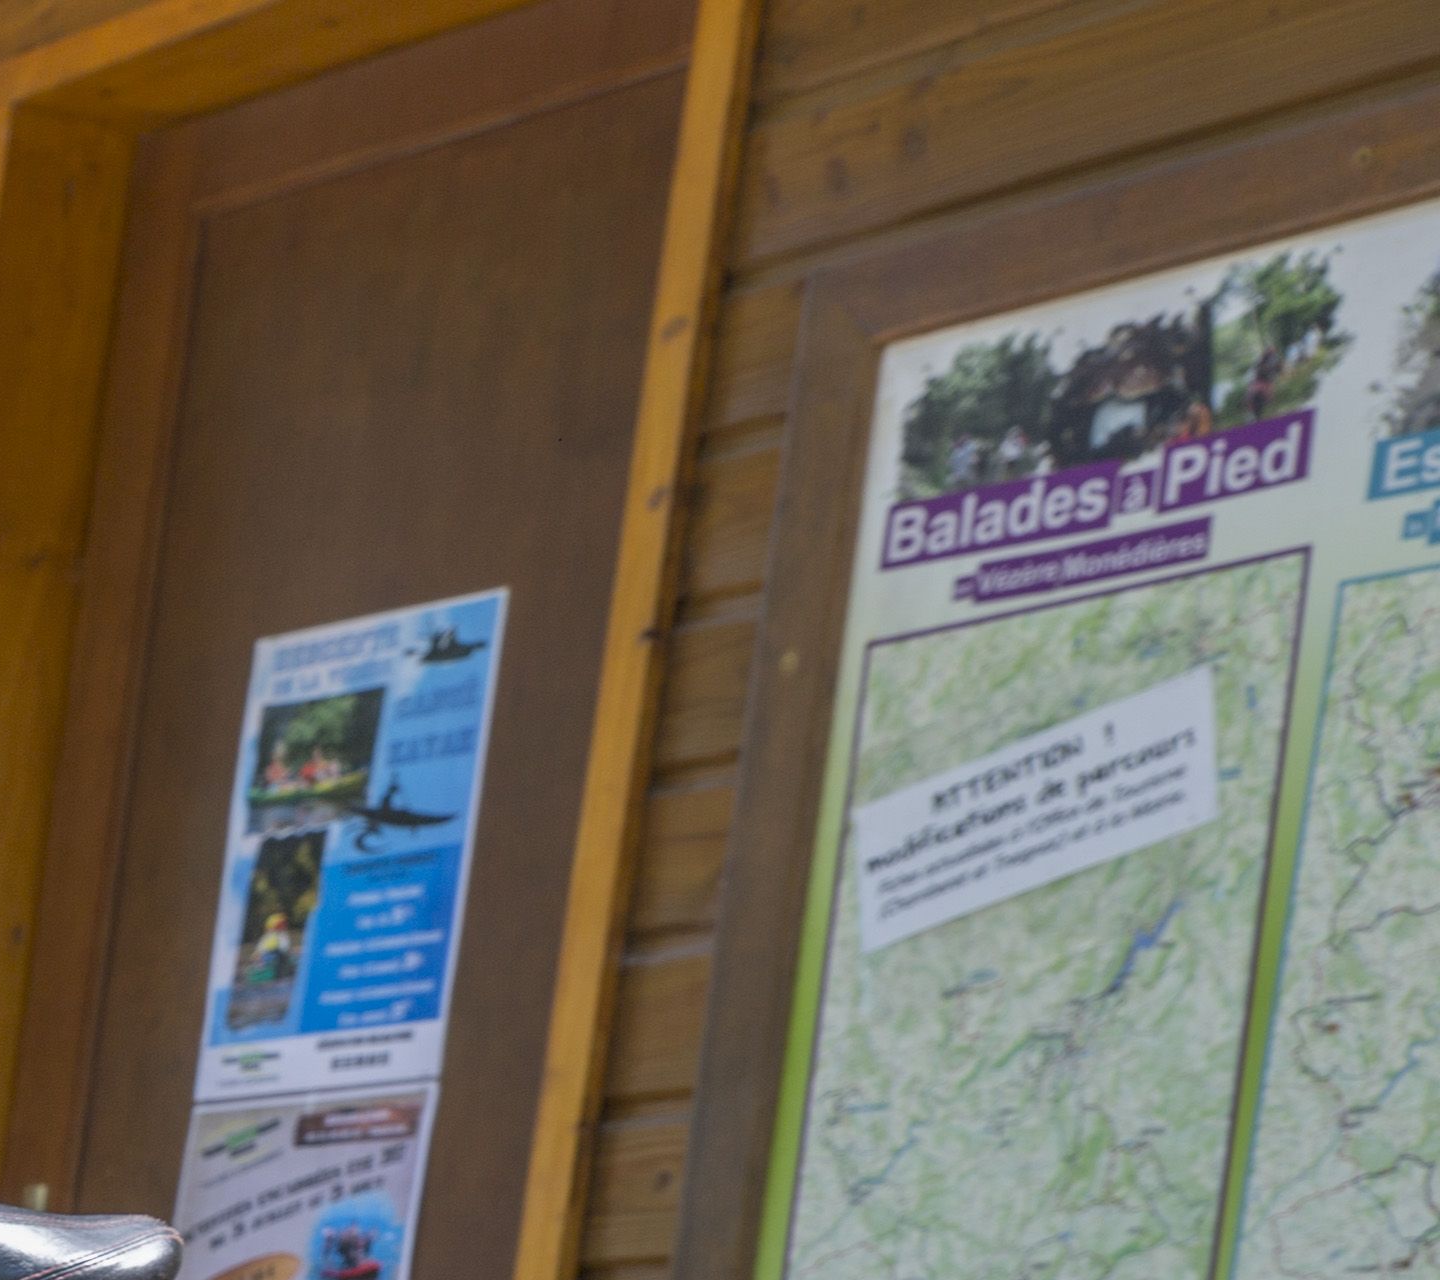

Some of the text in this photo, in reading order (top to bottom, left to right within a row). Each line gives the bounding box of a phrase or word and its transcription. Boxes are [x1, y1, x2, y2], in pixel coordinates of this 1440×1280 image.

[886, 421, 1303, 563] Balades à Pied
